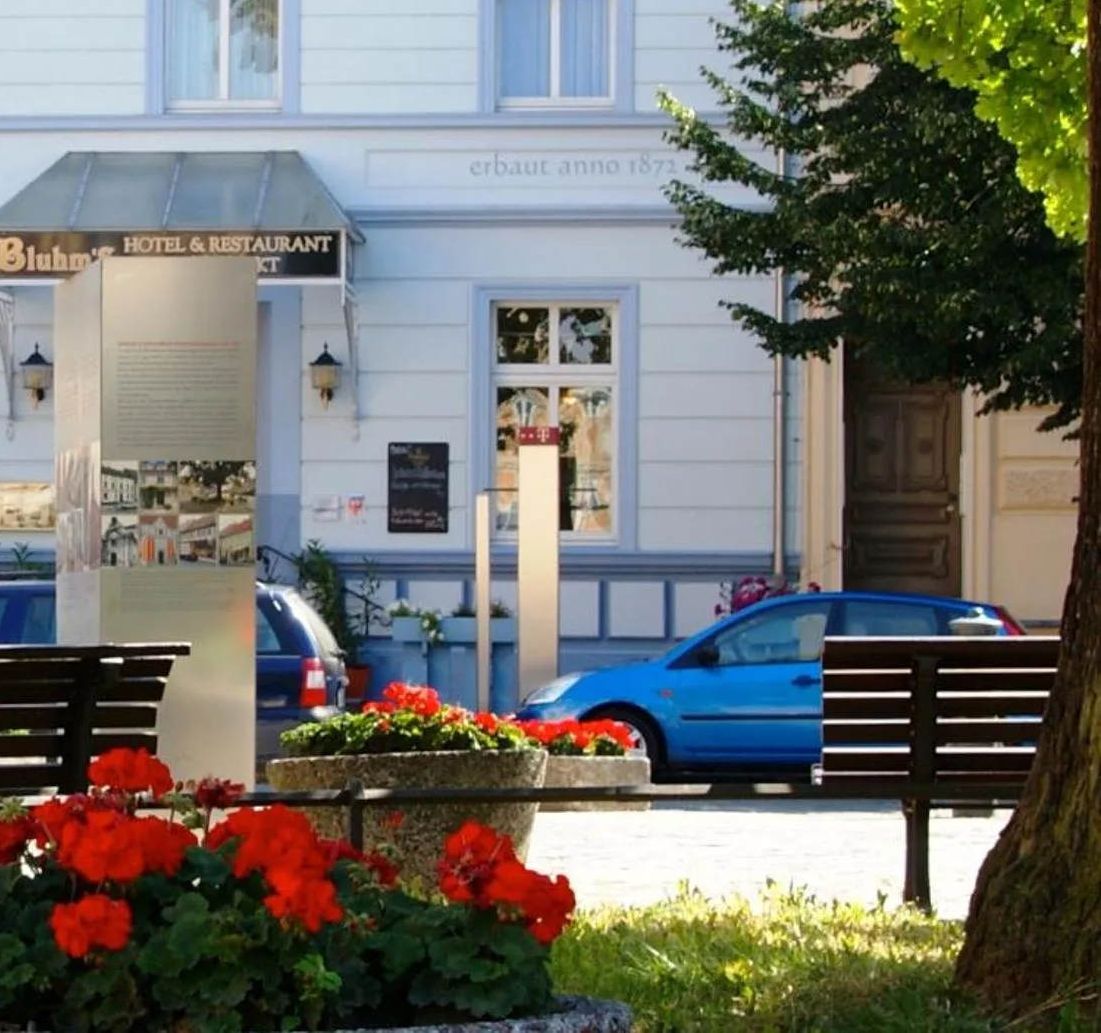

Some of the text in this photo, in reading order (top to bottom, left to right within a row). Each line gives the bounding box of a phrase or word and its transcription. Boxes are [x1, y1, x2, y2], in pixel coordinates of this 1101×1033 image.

[469, 152, 548, 177] erbaut
[558, 159, 620, 177] anno
[123, 236, 186, 253] HOTEL
[189, 236, 206, 253] &
[209, 235, 332, 253] RESTAURANT
